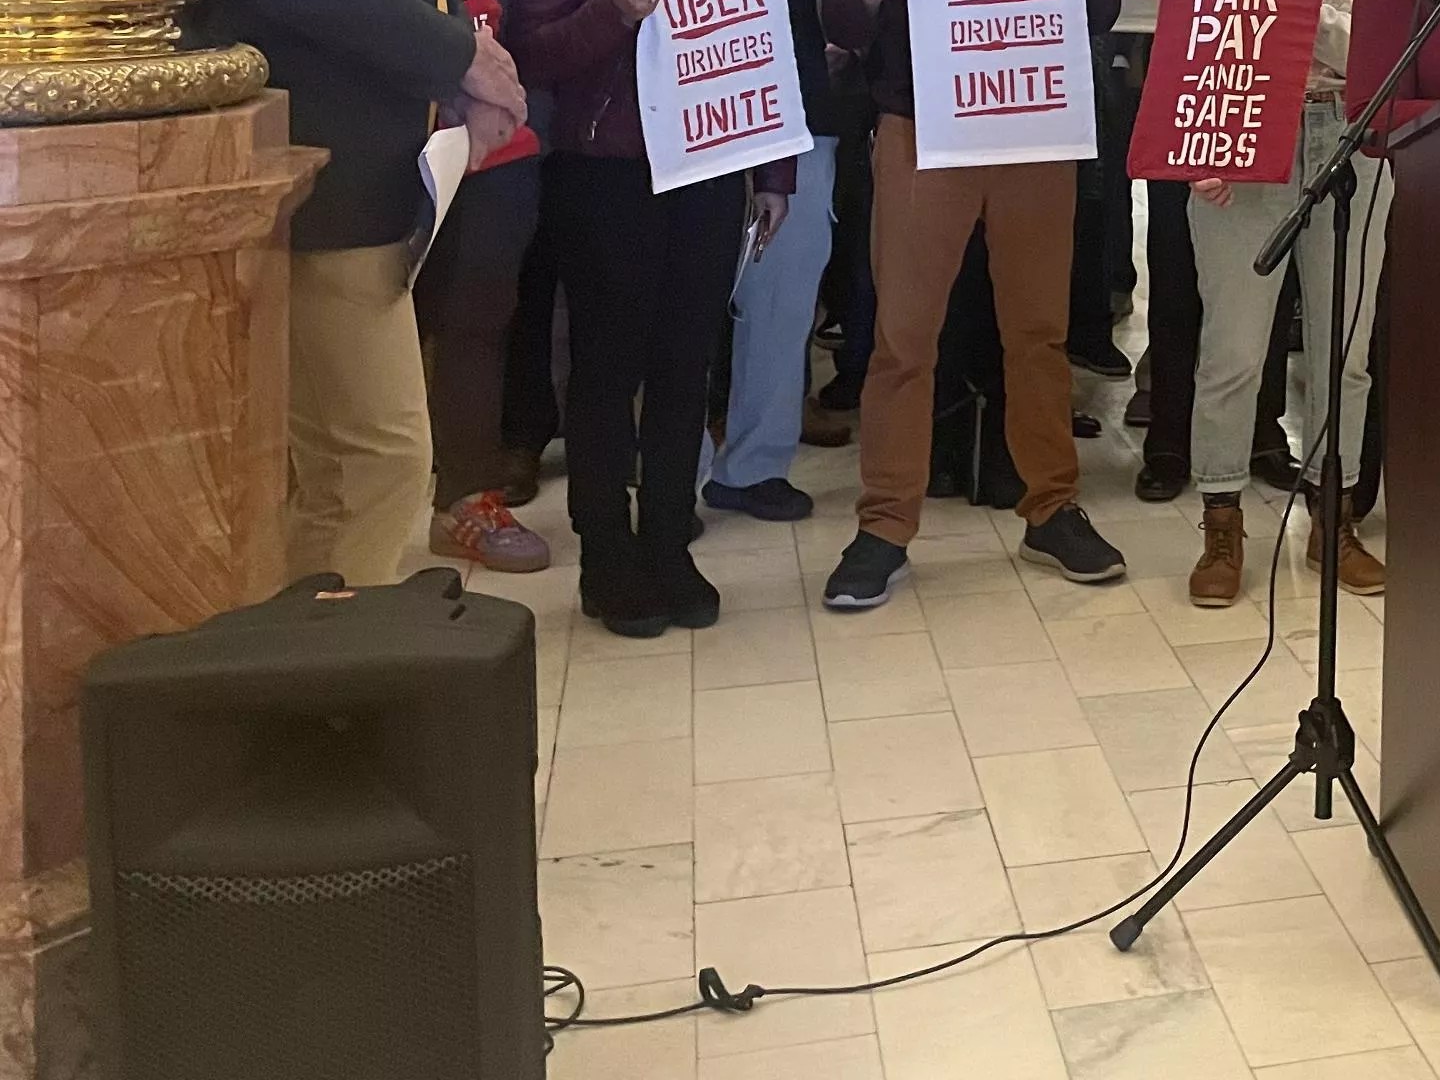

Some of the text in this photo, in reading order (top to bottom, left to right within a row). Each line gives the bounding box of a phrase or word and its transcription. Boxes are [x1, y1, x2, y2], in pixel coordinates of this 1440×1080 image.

[951, 13, 1063, 44] DRIVERS
[1186, 13, 1278, 61] PAY
[676, 31, 774, 78] DRIVERS
[954, 65, 1066, 108] UNITE
[683, 84, 782, 143] UNITE
[1174, 93, 1266, 128] SAFE
[1167, 131, 1257, 168] JOBS
